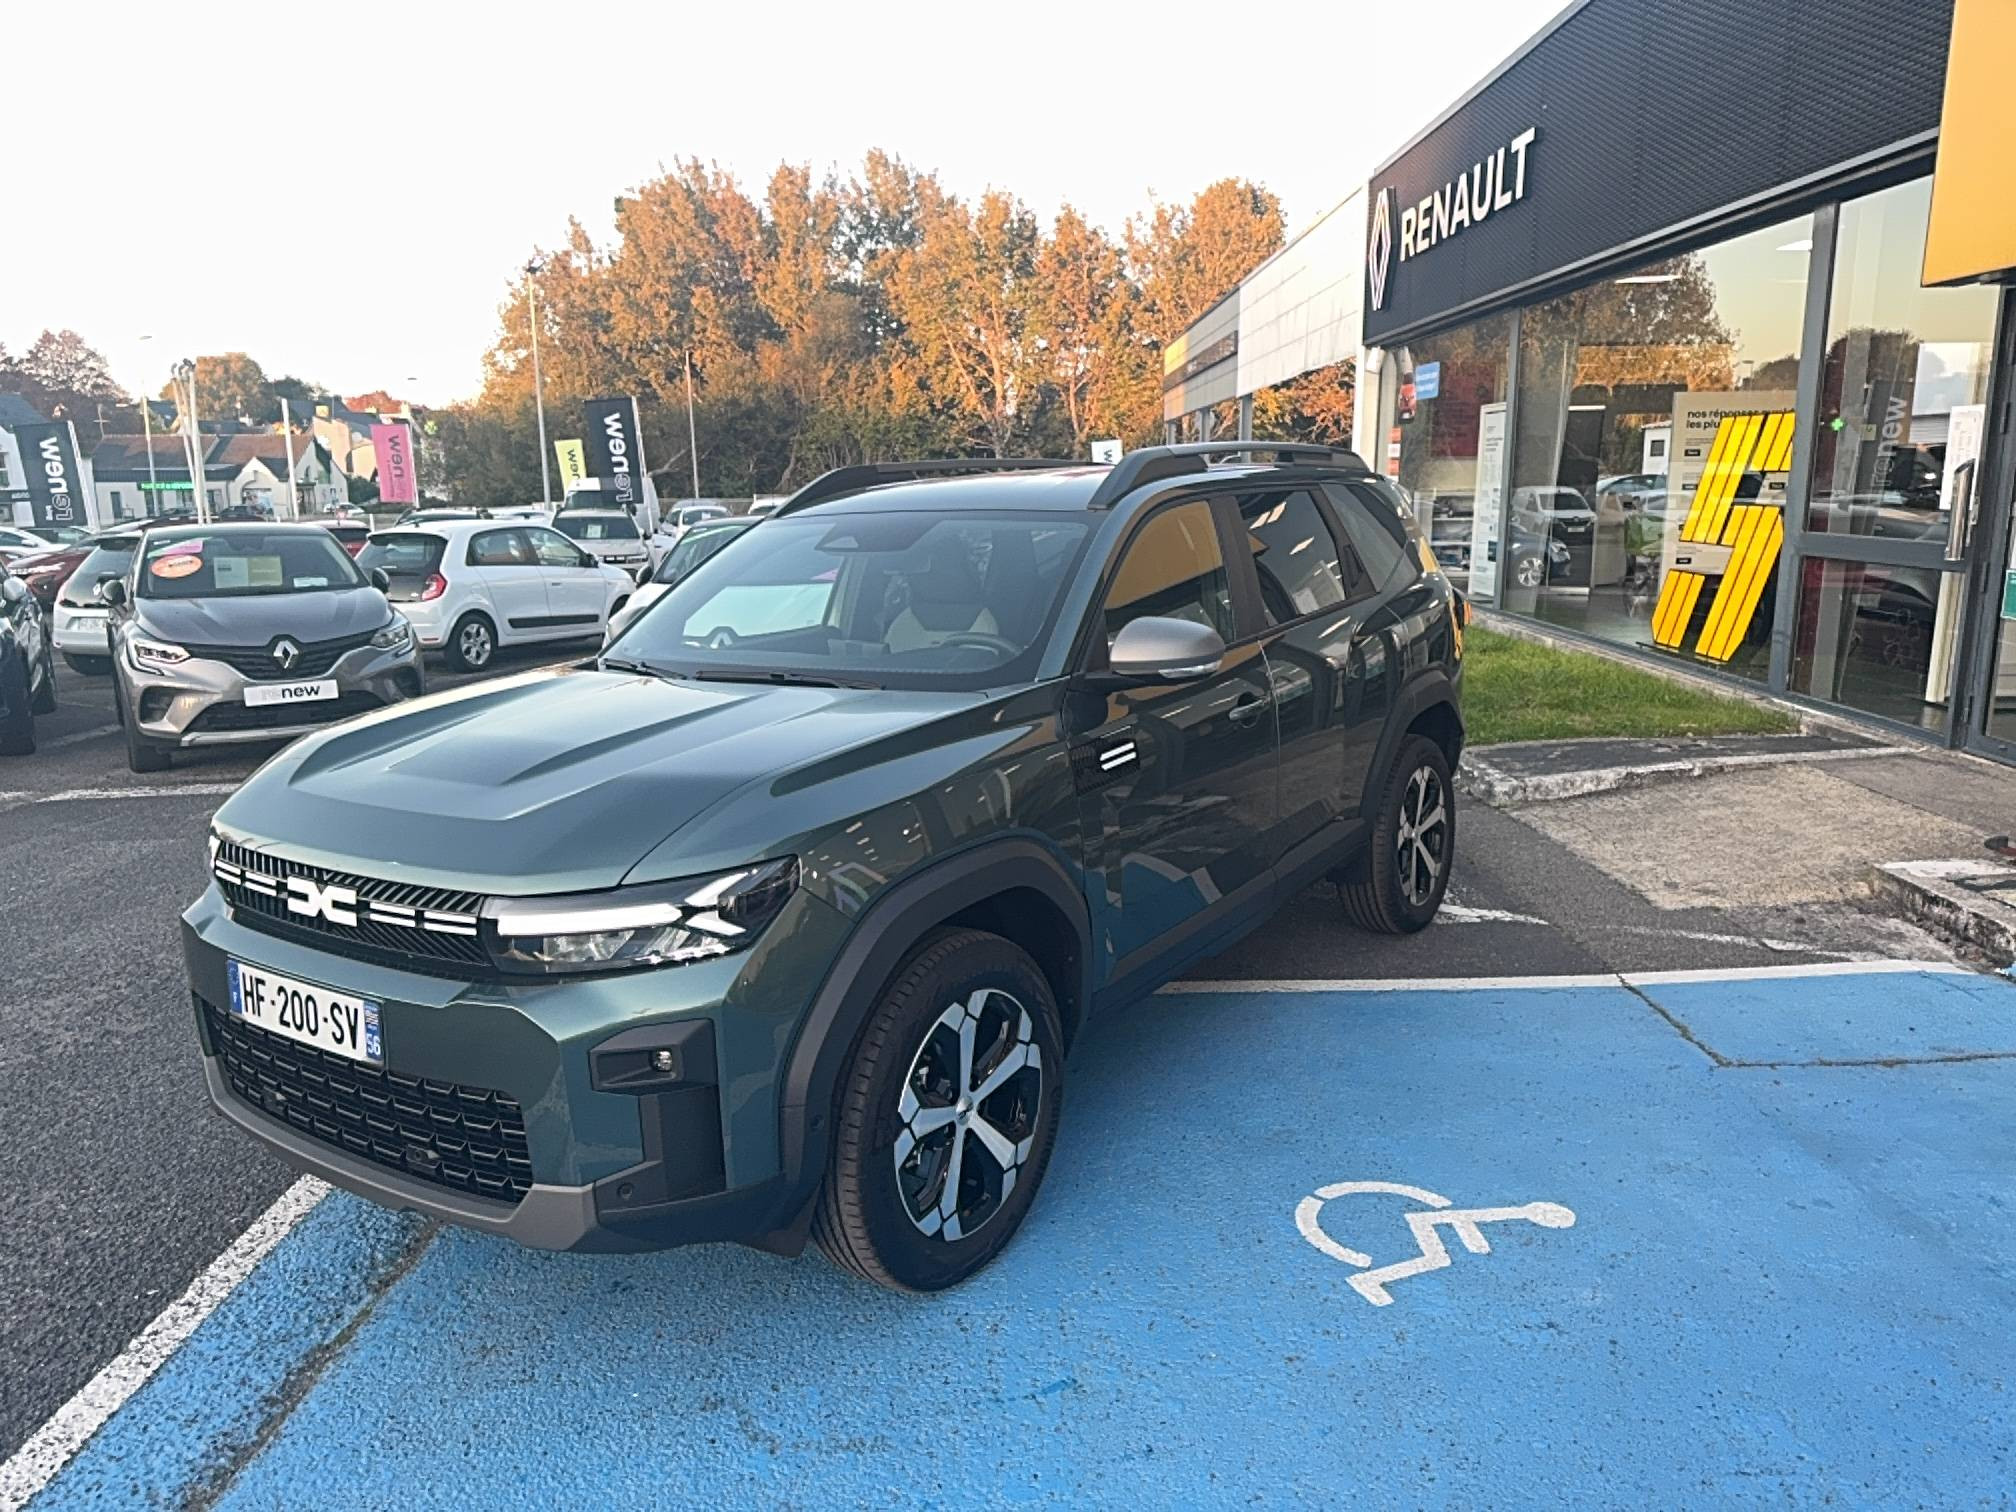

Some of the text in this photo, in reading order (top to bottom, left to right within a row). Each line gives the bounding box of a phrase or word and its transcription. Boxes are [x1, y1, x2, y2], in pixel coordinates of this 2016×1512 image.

[1400, 127, 1536, 262] RENAULT
[1687, 410, 1707, 419] nos
[1686, 419, 1721, 430] les plu
[365, 1033, 382, 1056] 56
